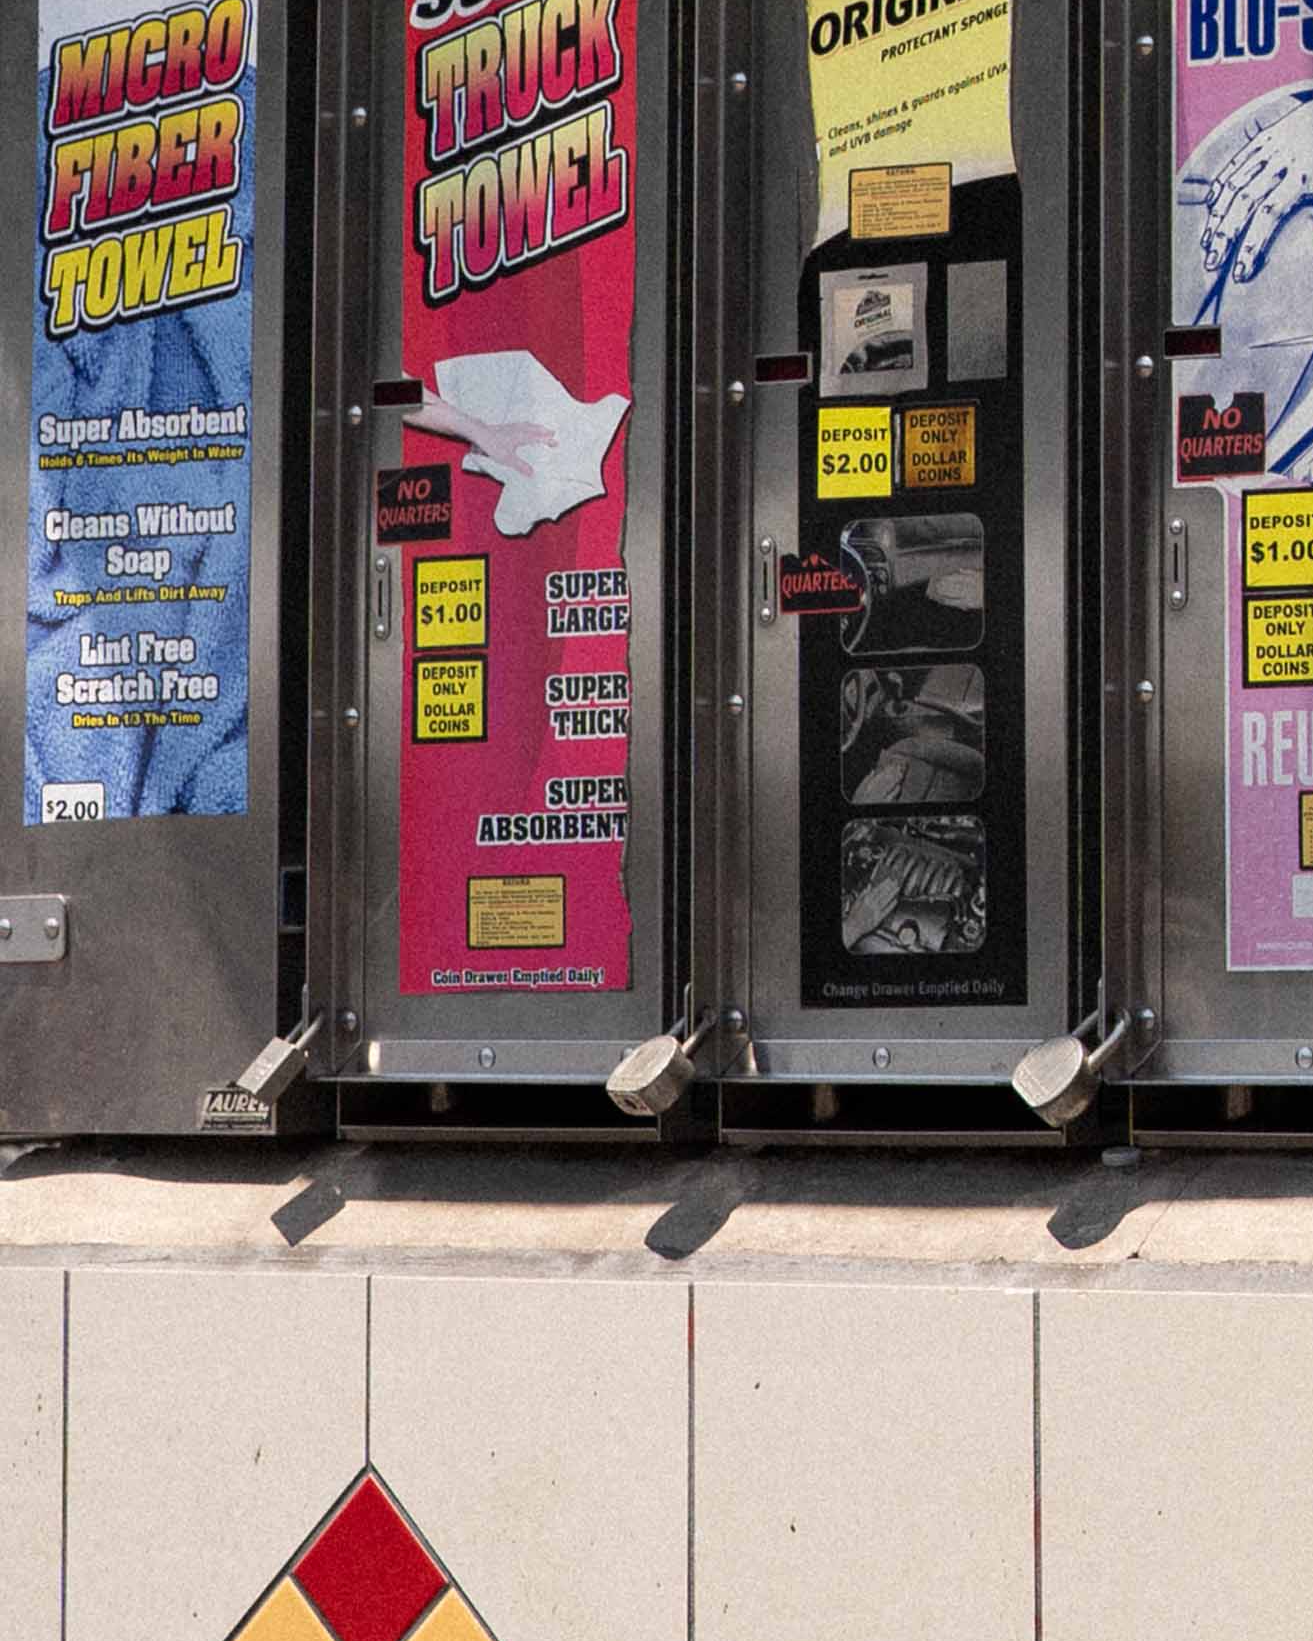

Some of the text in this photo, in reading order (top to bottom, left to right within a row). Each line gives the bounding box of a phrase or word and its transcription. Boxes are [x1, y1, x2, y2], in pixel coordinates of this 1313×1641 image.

[881, 2, 1009, 62] PROTECTANT SPONGE
[866, 106, 898, 126] shines
[901, 101, 909, 112] &
[911, 87, 945, 111] guards
[948, 71, 985, 96] against
[829, 140, 848, 157] and
[873, 118, 913, 140] damage
[47, 97, 241, 235] FIBER
[422, 107, 625, 295] TOWEL
[49, 208, 241, 329] TOWEL
[40, 405, 246, 450] Super Absorbent
[910, 411, 970, 428] DEPOSIT
[1202, 407, 1242, 431] NO
[821, 428, 888, 442] DEPOSIT
[921, 430, 959, 444] ONLY
[1179, 431, 1265, 462] QUARTERS
[88, 452, 123, 465] Times
[147, 448, 189, 465] Weight
[207, 445, 244, 458] Water
[822, 452, 888, 475] $2.00
[912, 450, 967, 466] DOLLAR
[918, 467, 962, 482] COINS
[398, 479, 432, 500] NO
[46, 502, 236, 541] Cleans Without
[379, 503, 451, 530] QUARTERS
[106, 545, 171, 581] Soap
[55, 585, 227, 607] Traps And Lifts Dirt Away
[420, 579, 482, 595] DEPOSIT
[547, 570, 628, 601] SUPER
[782, 570, 857, 599] QUARTER
[420, 602, 482, 626] $1.00
[549, 604, 629, 634] LARGE
[1265, 621, 1306, 637] ONLY
[80, 631, 196, 666] Lint Free
[422, 665, 478, 680] DEPOSIT
[1262, 660, 1311, 677] COINS
[56, 669, 219, 704] Scratch Free
[432, 682, 466, 696] ONLY
[547, 673, 628, 703] SUPER
[73, 714, 104, 728] Dries
[107, 713, 119, 726] In
[144, 712, 167, 724] The
[170, 711, 201, 724] Time
[424, 702, 475, 717] DOLLAR
[428, 719, 470, 733] COINS
[553, 708, 628, 737] THICK
[547, 778, 628, 807] SUPER
[46, 799, 99, 820] $2.00
[478, 813, 627, 843] ABSORBENT
[432, 971, 460, 985] Coin
[512, 968, 563, 987] Emptied
